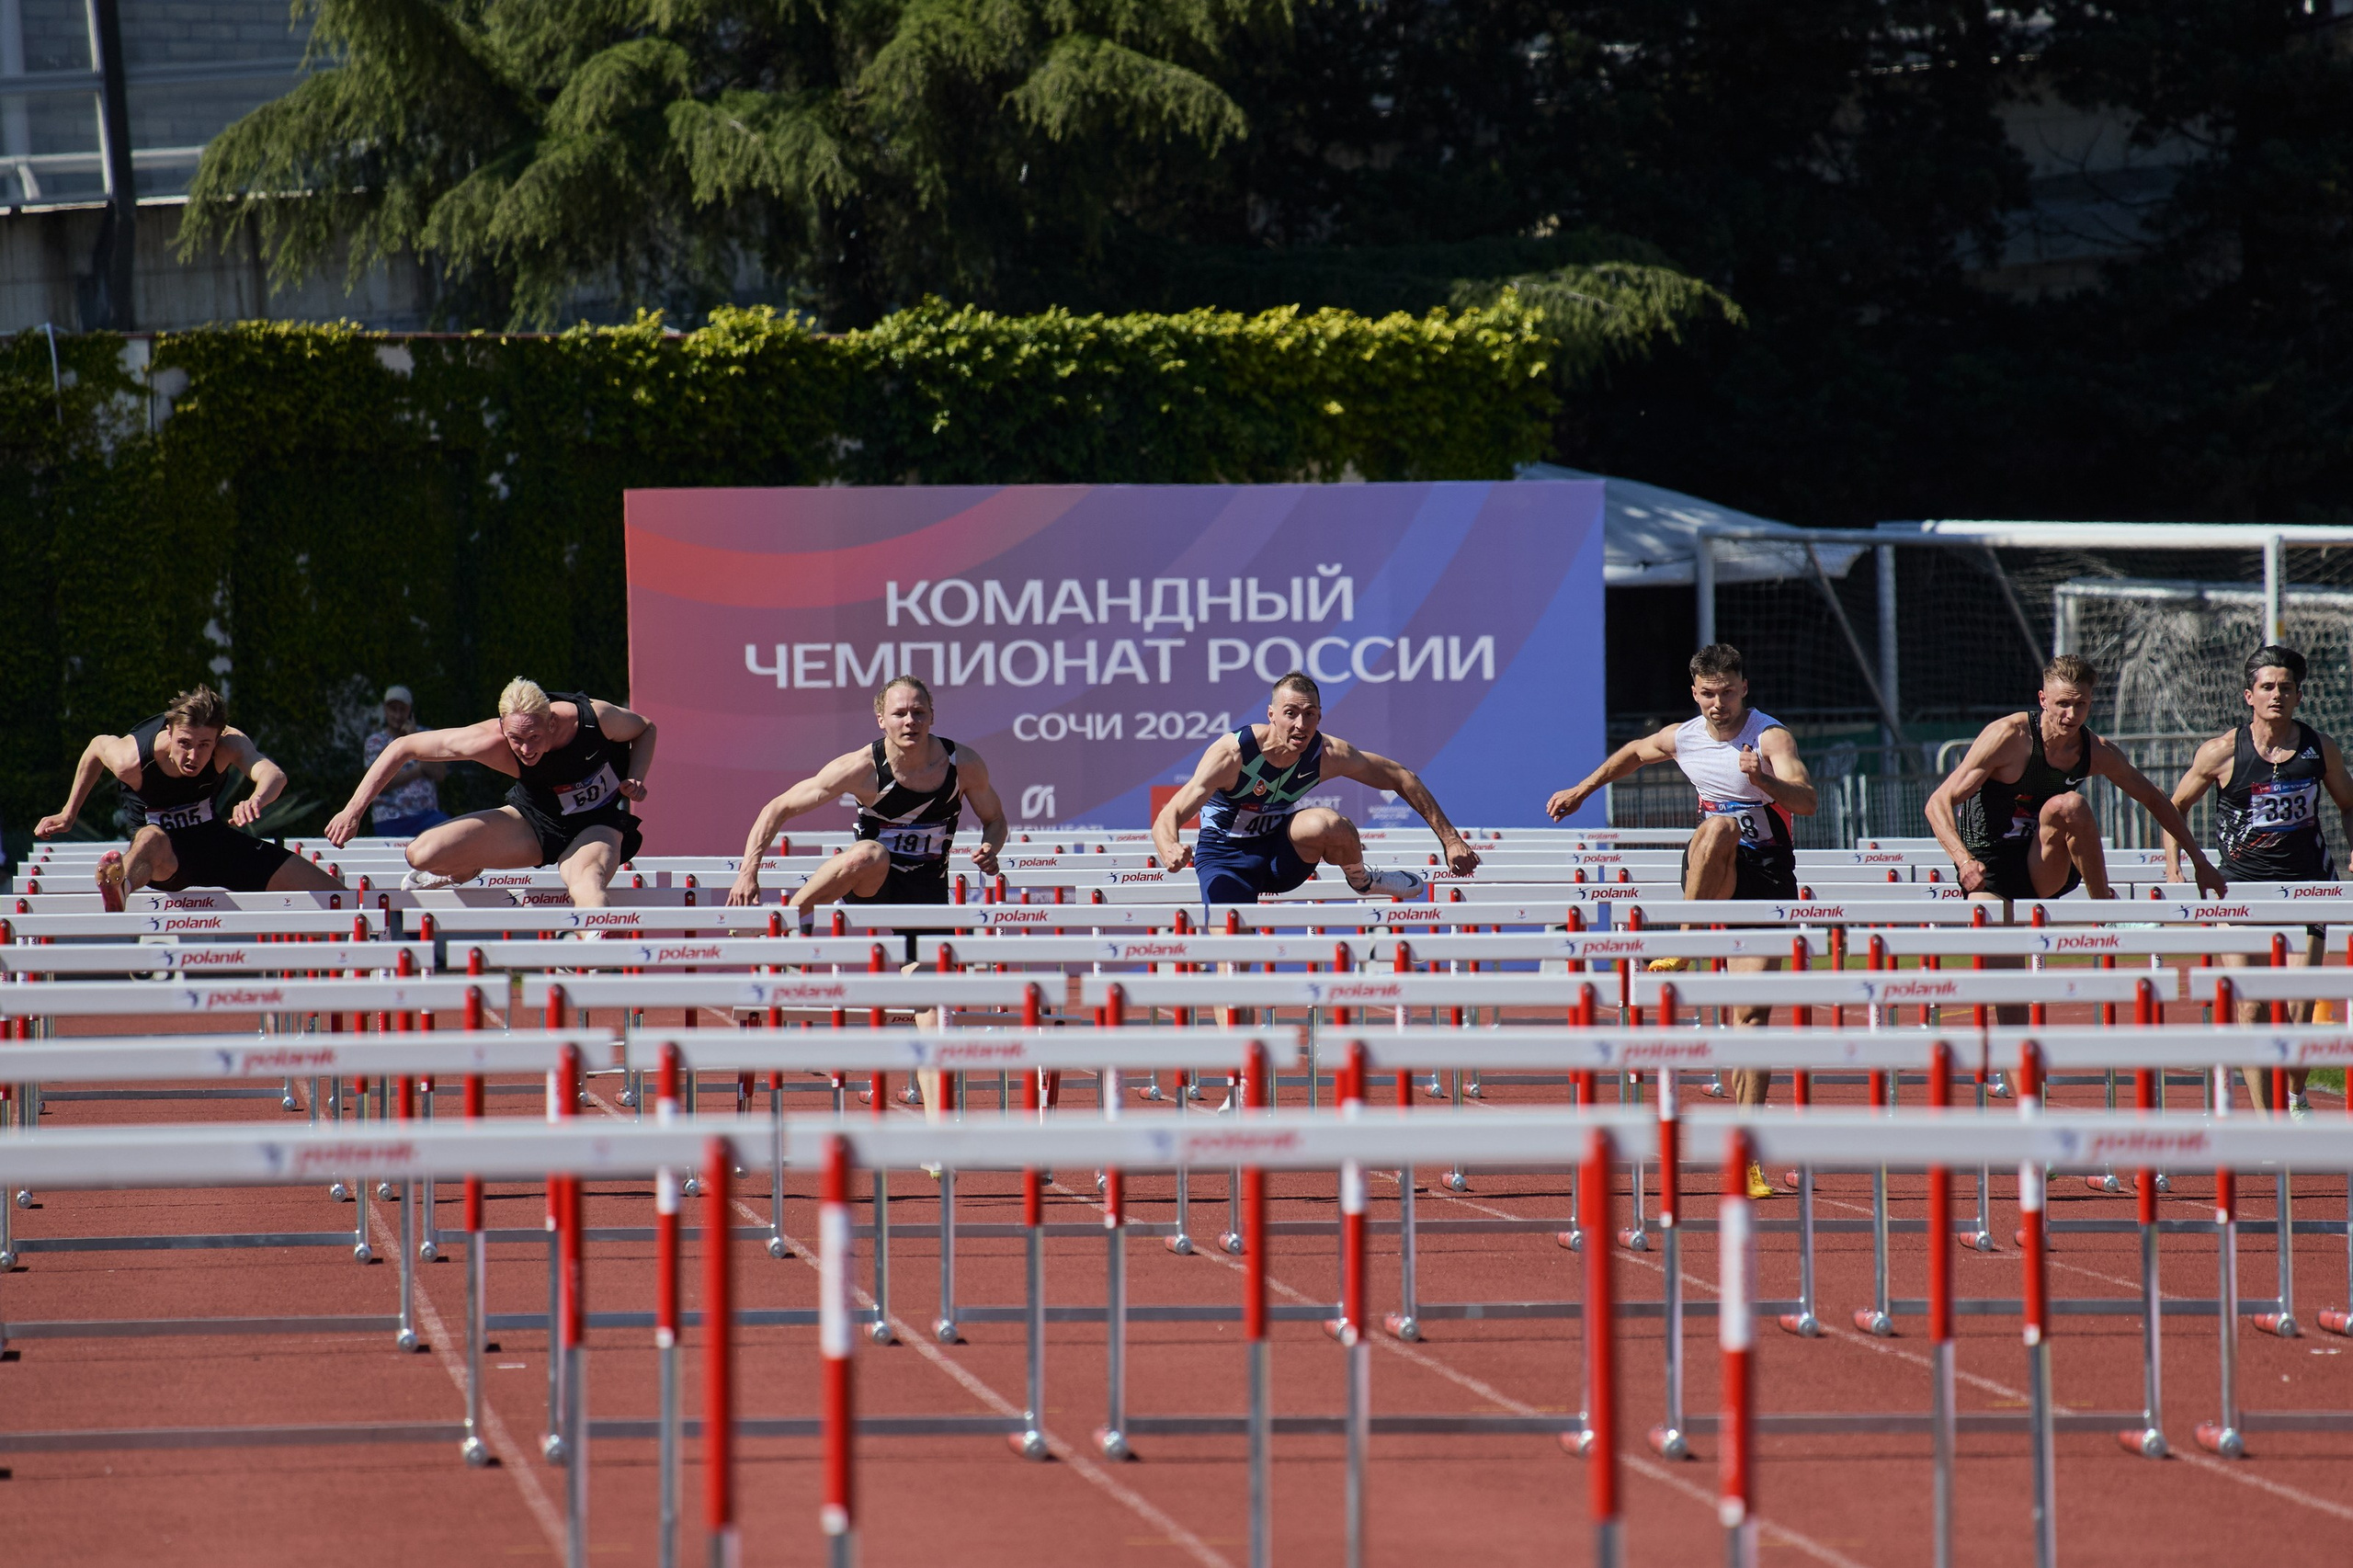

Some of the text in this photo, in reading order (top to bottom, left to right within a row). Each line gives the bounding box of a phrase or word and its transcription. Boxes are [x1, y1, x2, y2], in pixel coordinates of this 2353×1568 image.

[885, 563, 1354, 632] КОМАНДНЫЙ
[745, 635, 1495, 689] ЧЕМПИОНАТ РОССИИ
[1013, 711, 1232, 741] СОЧИ 2024
[2265, 795, 2307, 822] 333
[893, 834, 932, 852] 191
[1018, 858, 1058, 869] polanik
[1583, 853, 1622, 863] polanik
[1865, 853, 1904, 863] polanik
[488, 875, 532, 887] polanik
[1121, 871, 1164, 883] polanik
[521, 892, 571, 907] polanik
[1591, 887, 1640, 901] polanik
[2293, 885, 2344, 899] polanik
[164, 895, 215, 911] polanik
[585, 912, 642, 928] polanik
[994, 909, 1049, 925] polanik
[1386, 907, 1443, 923] polanik
[1790, 905, 1845, 920] polanik
[2194, 904, 2251, 920] polanik
[165, 915, 222, 932] polanik
[1124, 941, 1188, 960] polanik
[1582, 938, 1645, 957] polanik
[2056, 934, 2120, 952] polanik
[180, 949, 246, 968] polanik
[658, 945, 723, 963] polanik
[1883, 979, 1959, 1001] polanik
[207, 987, 286, 1010] polanik
